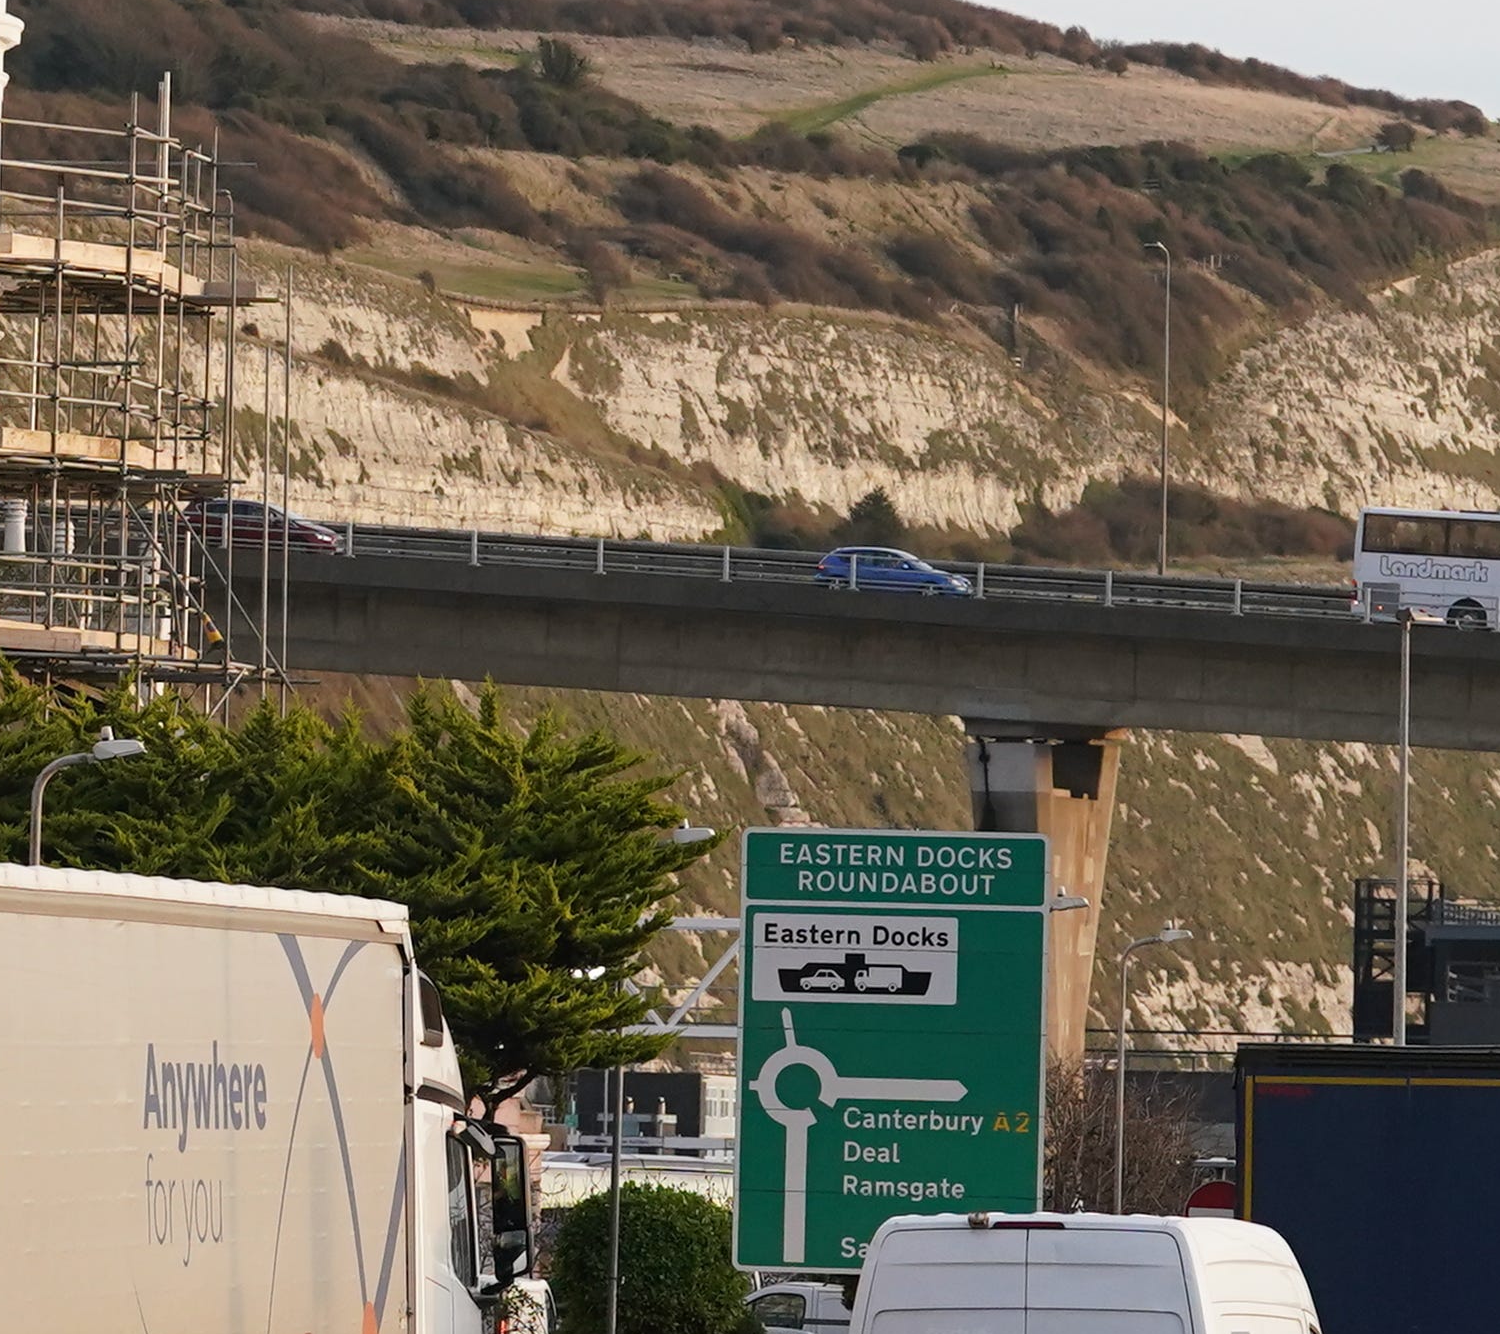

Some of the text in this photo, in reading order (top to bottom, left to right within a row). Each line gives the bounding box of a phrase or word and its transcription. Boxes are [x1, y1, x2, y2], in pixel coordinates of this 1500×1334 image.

[1380, 555, 1488, 582] Landmark
[779, 843, 1012, 870] EASTERN DOCKS
[798, 870, 995, 896] ROUNDABOUT
[764, 923, 949, 948] Eastern Docks
[144, 1040, 267, 1154] Anywhere
[843, 1107, 1030, 1136] Canterbury A2
[844, 1141, 900, 1164] Deal
[842, 1176, 965, 1202] Ramsgate
[145, 1153, 223, 1267] for you
